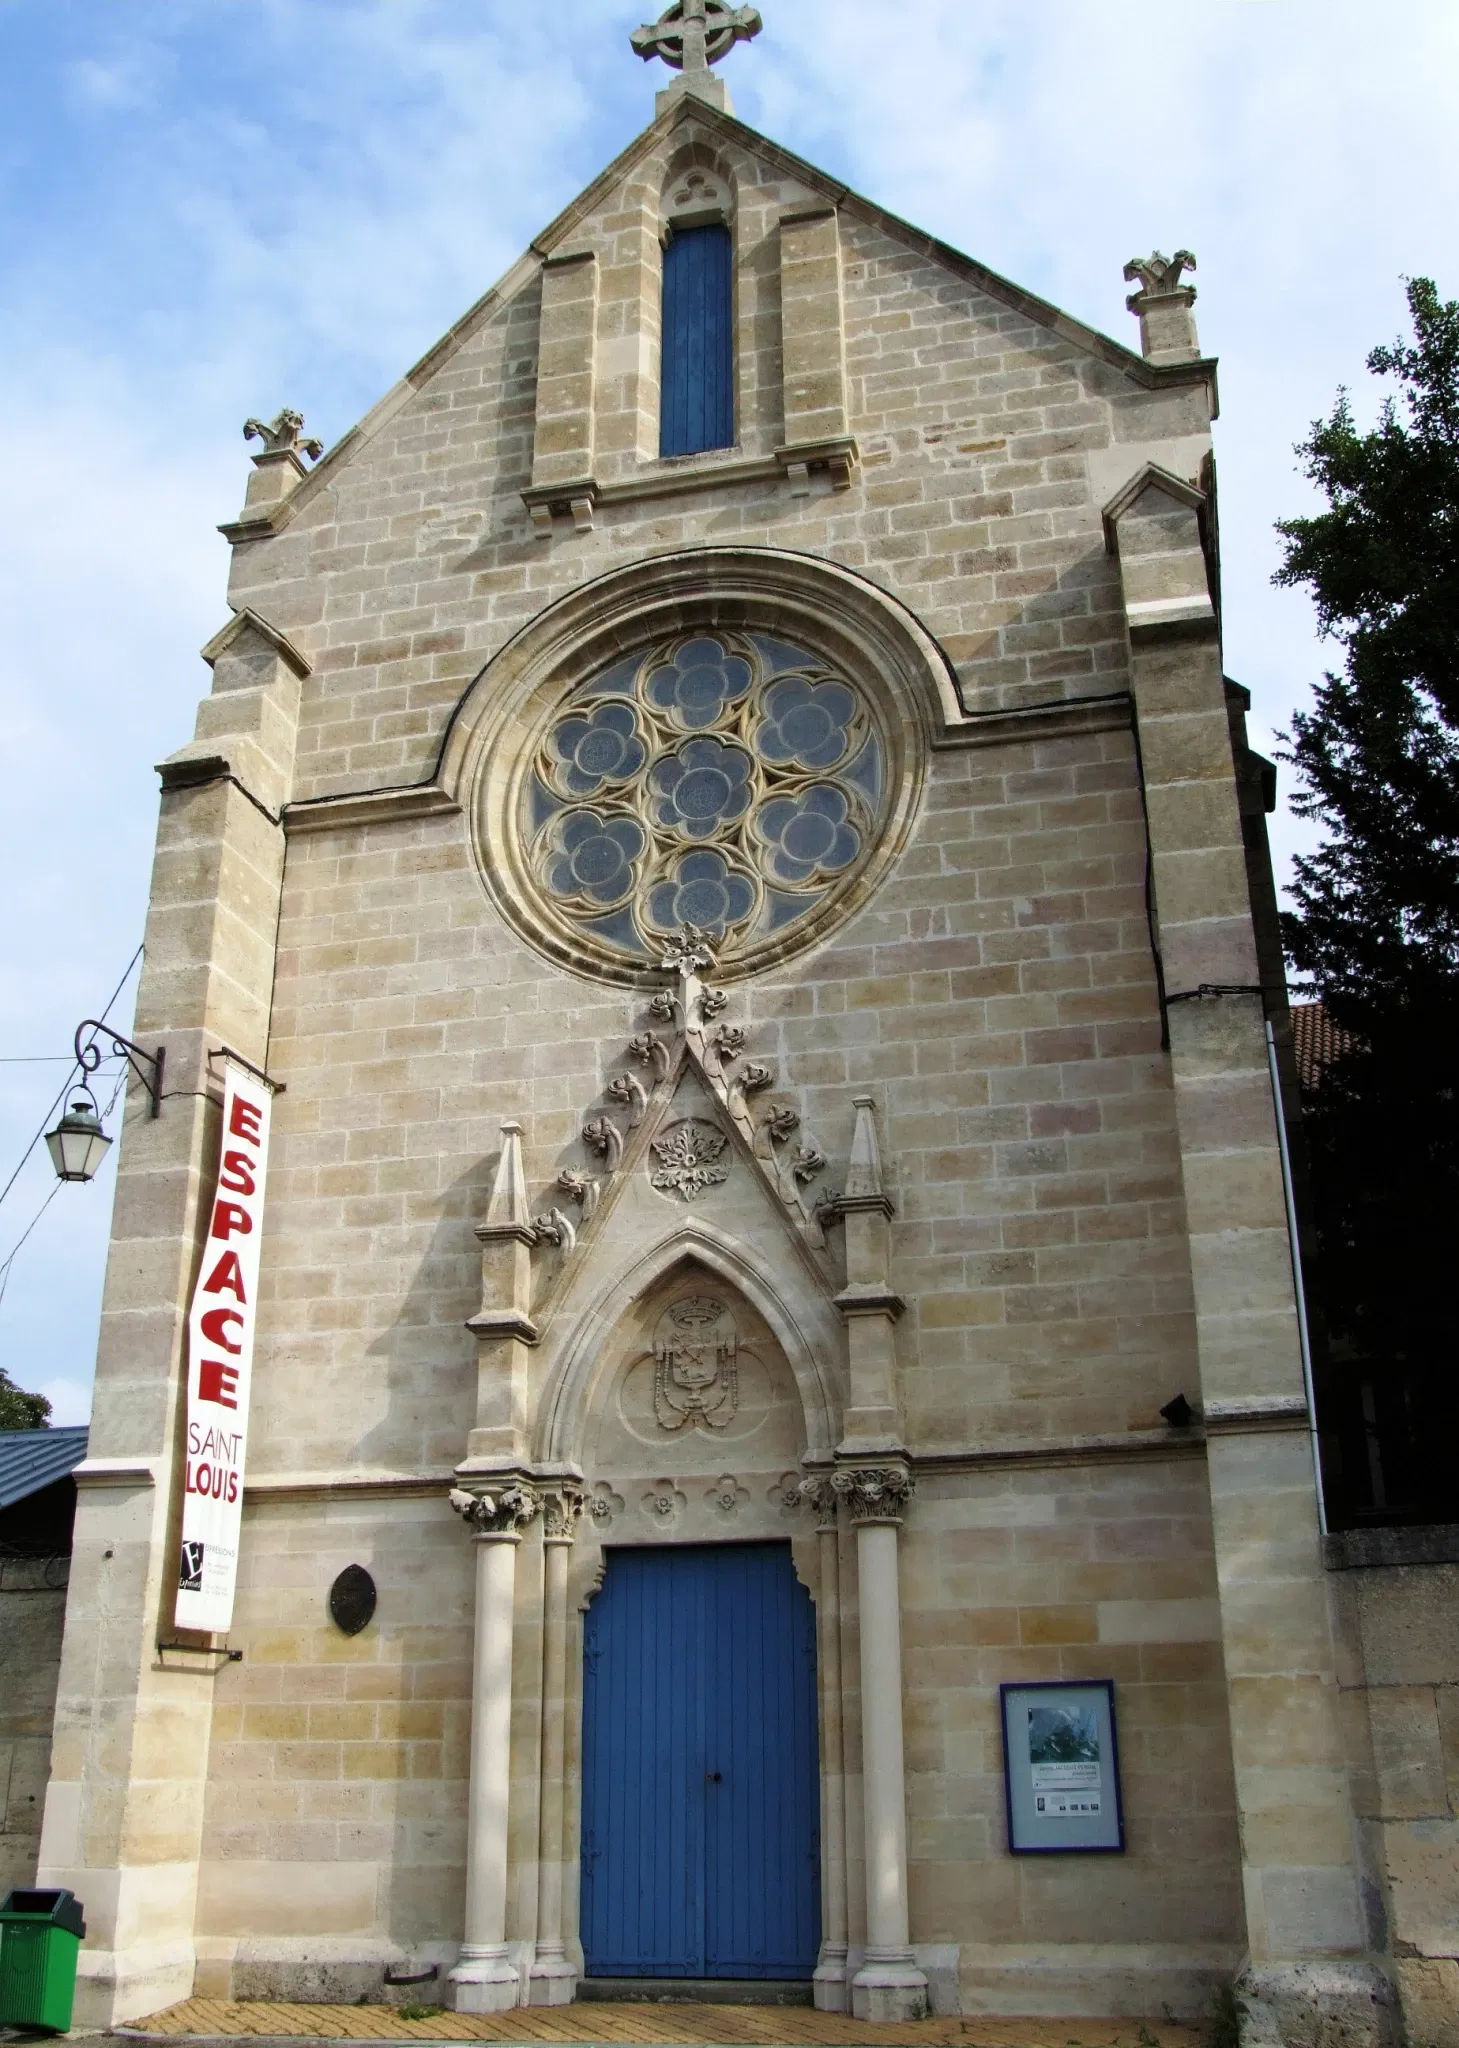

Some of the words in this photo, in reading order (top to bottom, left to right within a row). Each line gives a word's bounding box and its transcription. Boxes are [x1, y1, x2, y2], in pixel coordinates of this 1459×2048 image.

[198, 1092, 262, 1411] ESPACE
[188, 1422, 243, 1465] SAINT
[186, 1461, 239, 1503] LOUIS
